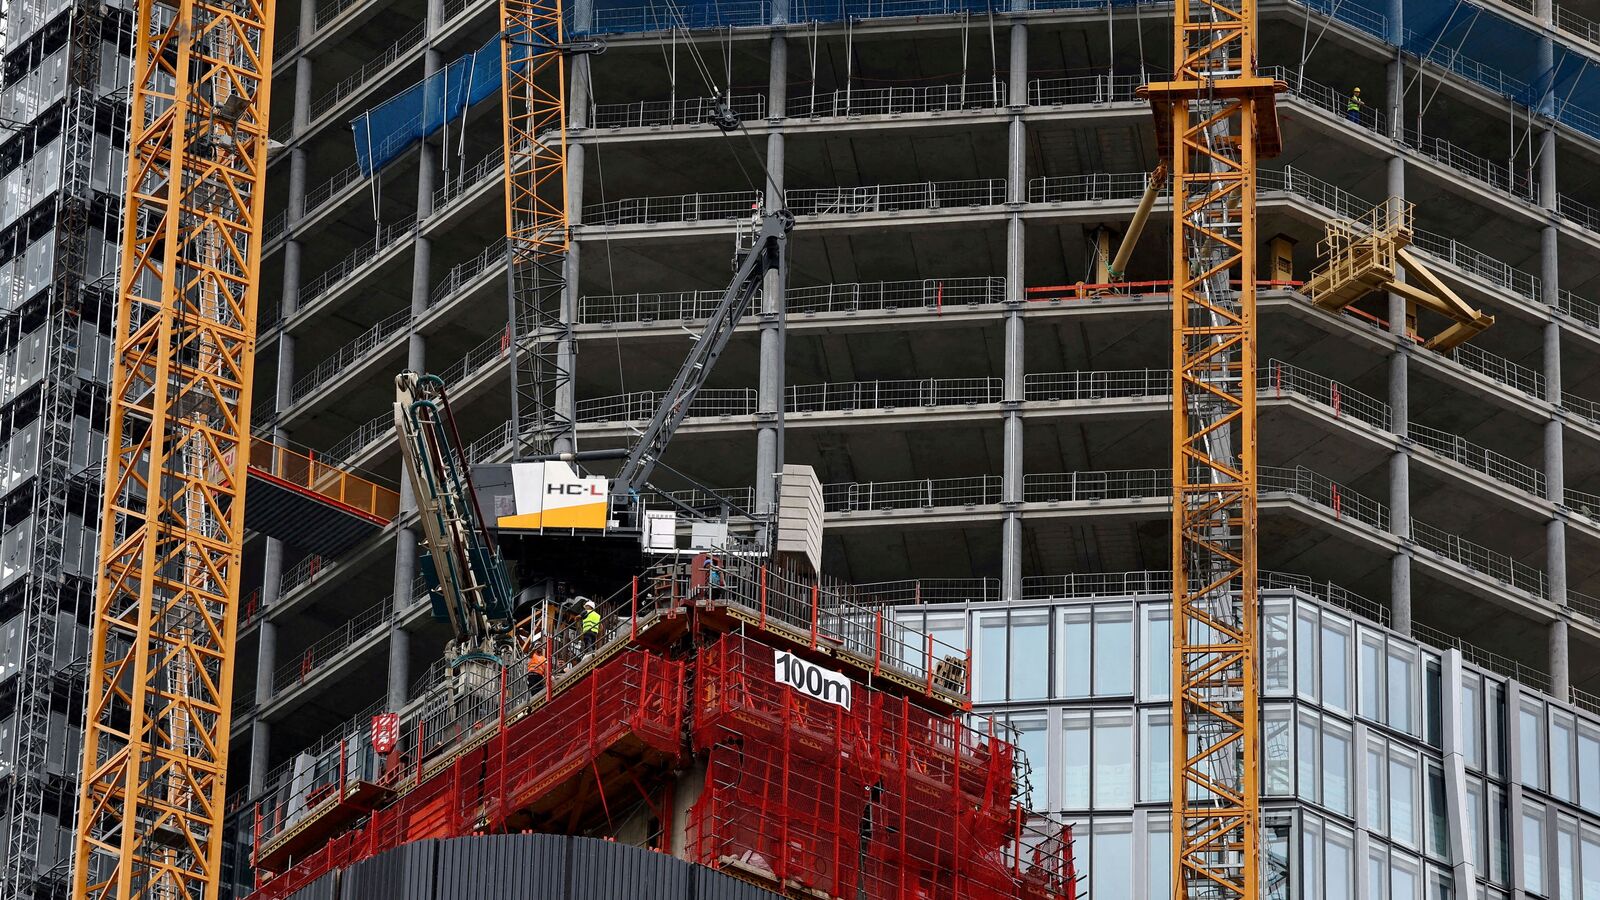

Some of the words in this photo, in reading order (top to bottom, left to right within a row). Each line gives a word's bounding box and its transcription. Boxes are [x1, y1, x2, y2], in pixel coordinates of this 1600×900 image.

[213, 451, 234, 477] PRI
[547, 484, 604, 495] HC-L
[777, 654, 849, 708] 100m
